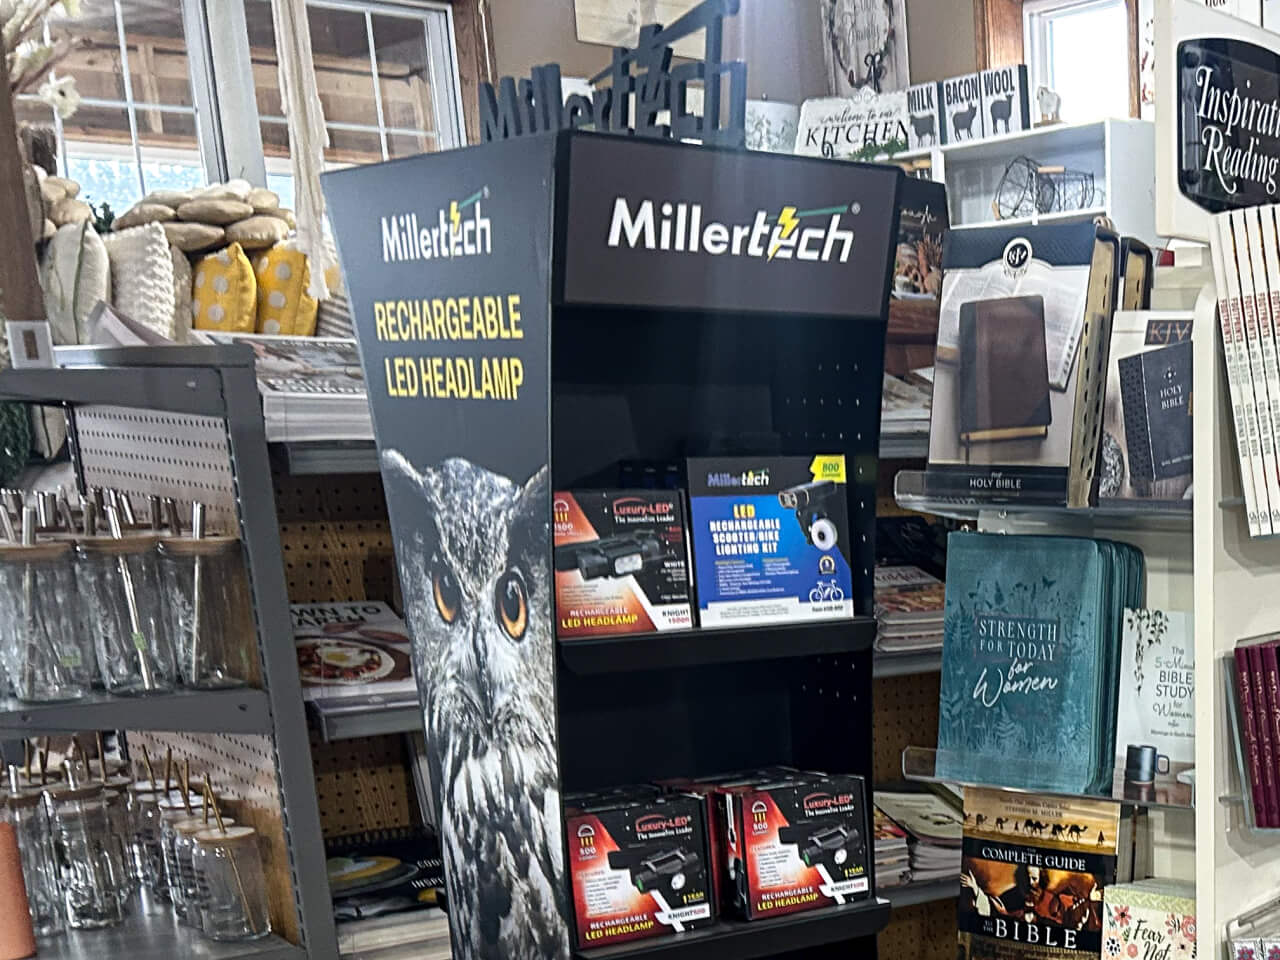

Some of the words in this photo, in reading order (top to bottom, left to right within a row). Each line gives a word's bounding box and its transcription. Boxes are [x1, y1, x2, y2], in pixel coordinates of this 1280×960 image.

[945, 78, 979, 106] BACON
[983, 68, 1015, 95] WOOL
[906, 86, 935, 113] MILK
[1201, 124, 1280, 196] Reading
[382, 200, 492, 263] Millertech
[607, 197, 856, 265] Millertech
[374, 293, 524, 343] RECHARGEABLE
[1149, 322, 1193, 344] KJV
[385, 356, 419, 398] LED
[420, 356, 525, 401] HEADLAMP
[1159, 384, 1183, 400] HOLY
[1160, 396, 1185, 411] BIBLE
[822, 462, 841, 474] 800
[969, 477, 995, 490] HOLY
[995, 478, 1023, 491] BIBLE
[612, 502, 671, 516] Luxury-LED
[734, 504, 756, 519] LED
[709, 517, 781, 533] RECHARGEABLE
[712, 531, 780, 544] SCOOTER/BIKE
[715, 542, 763, 557] LIGHTING
[763, 542, 779, 555] KIT
[561, 617, 582, 630] LED
[582, 613, 639, 629] HEADLAMP
[661, 608, 690, 619] KNIGHT
[978, 619, 1058, 642] STRENGTH
[979, 638, 1004, 653] FOR
[1007, 639, 1057, 662] TODAY
[1007, 657, 1034, 681] for
[1158, 670, 1194, 686] BIBLE
[972, 668, 1059, 708] Women
[1155, 684, 1195, 699] STUDY
[635, 815, 691, 833] Luxury-LED
[982, 846, 1043, 867] COMPLETE
[1045, 854, 1087, 872] GUIDE
[605, 920, 654, 939] HEADLAMP
[994, 917, 1078, 950] BIBLE
[1131, 918, 1167, 945] Fear
